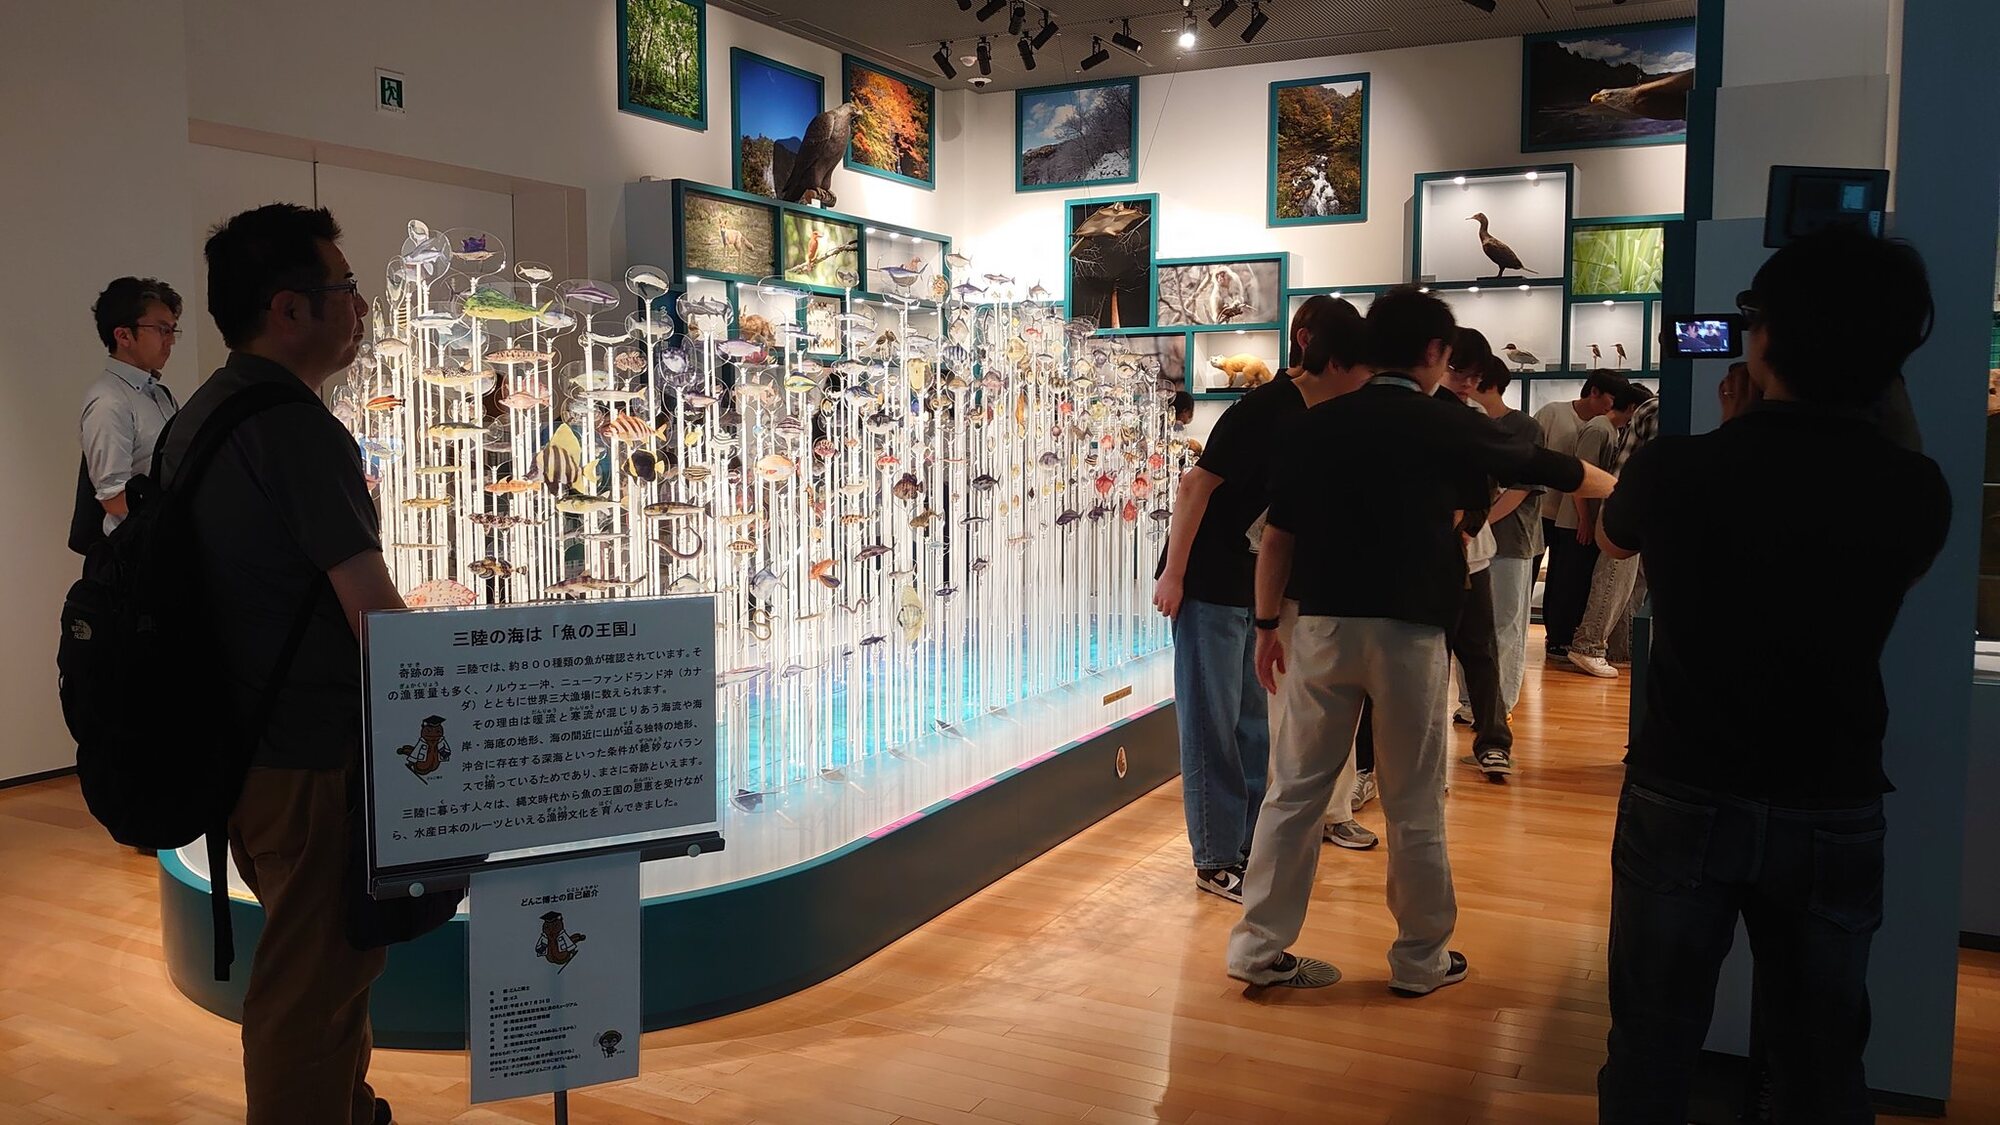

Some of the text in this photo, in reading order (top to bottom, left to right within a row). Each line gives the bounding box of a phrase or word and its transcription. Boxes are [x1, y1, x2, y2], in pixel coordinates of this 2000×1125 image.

[452, 620, 638, 648] 三陸の海は「魚の王国」
[398, 665, 445, 679] 奇跡の海
